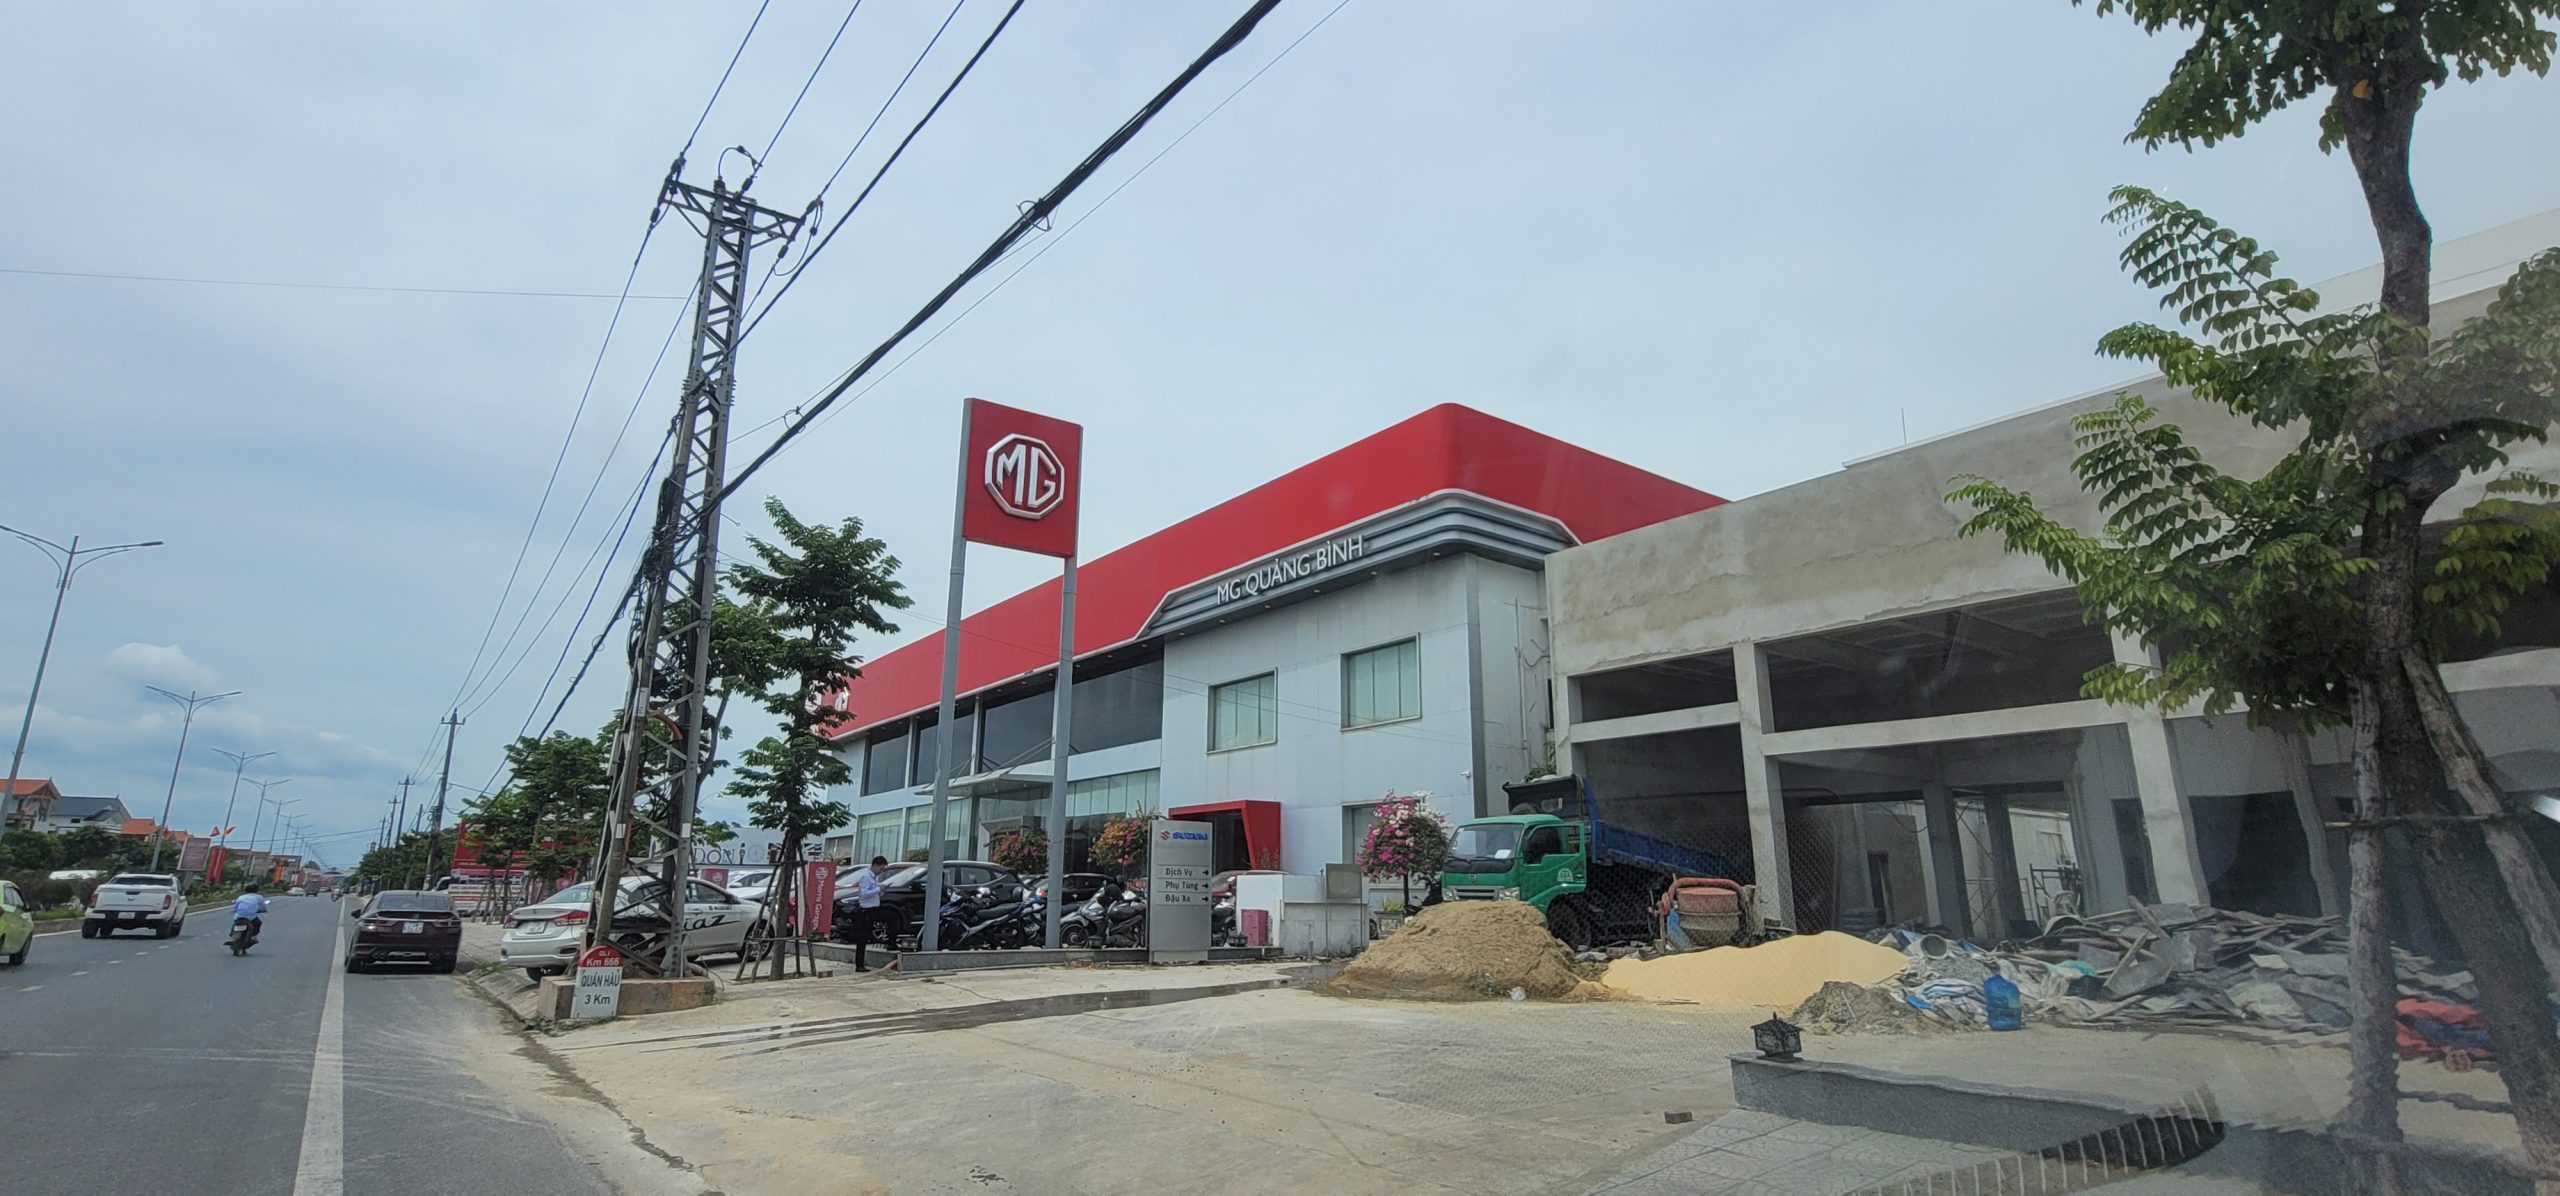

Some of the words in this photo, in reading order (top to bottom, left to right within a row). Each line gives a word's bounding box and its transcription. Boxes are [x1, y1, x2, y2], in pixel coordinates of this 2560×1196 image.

[997, 444, 1056, 508] MG
[1217, 579, 1241, 605] MG
[1245, 554, 1310, 595] QUẢNG
[1316, 534, 1364, 571] BÌNH
[1172, 832, 1208, 840] SUZUKI
[1165, 868, 1182, 877] Dịch
[1184, 868, 1193, 878] Vụ
[1165, 881, 1180, 890] Phụ
[1182, 881, 1199, 891] Tùng
[1182, 895, 1191, 903] Xe
[586, 959, 602, 967] Km
[581, 972, 603, 988] QUÁN
[584, 994, 592, 1005] 3
[593, 994, 611, 1005] Km
